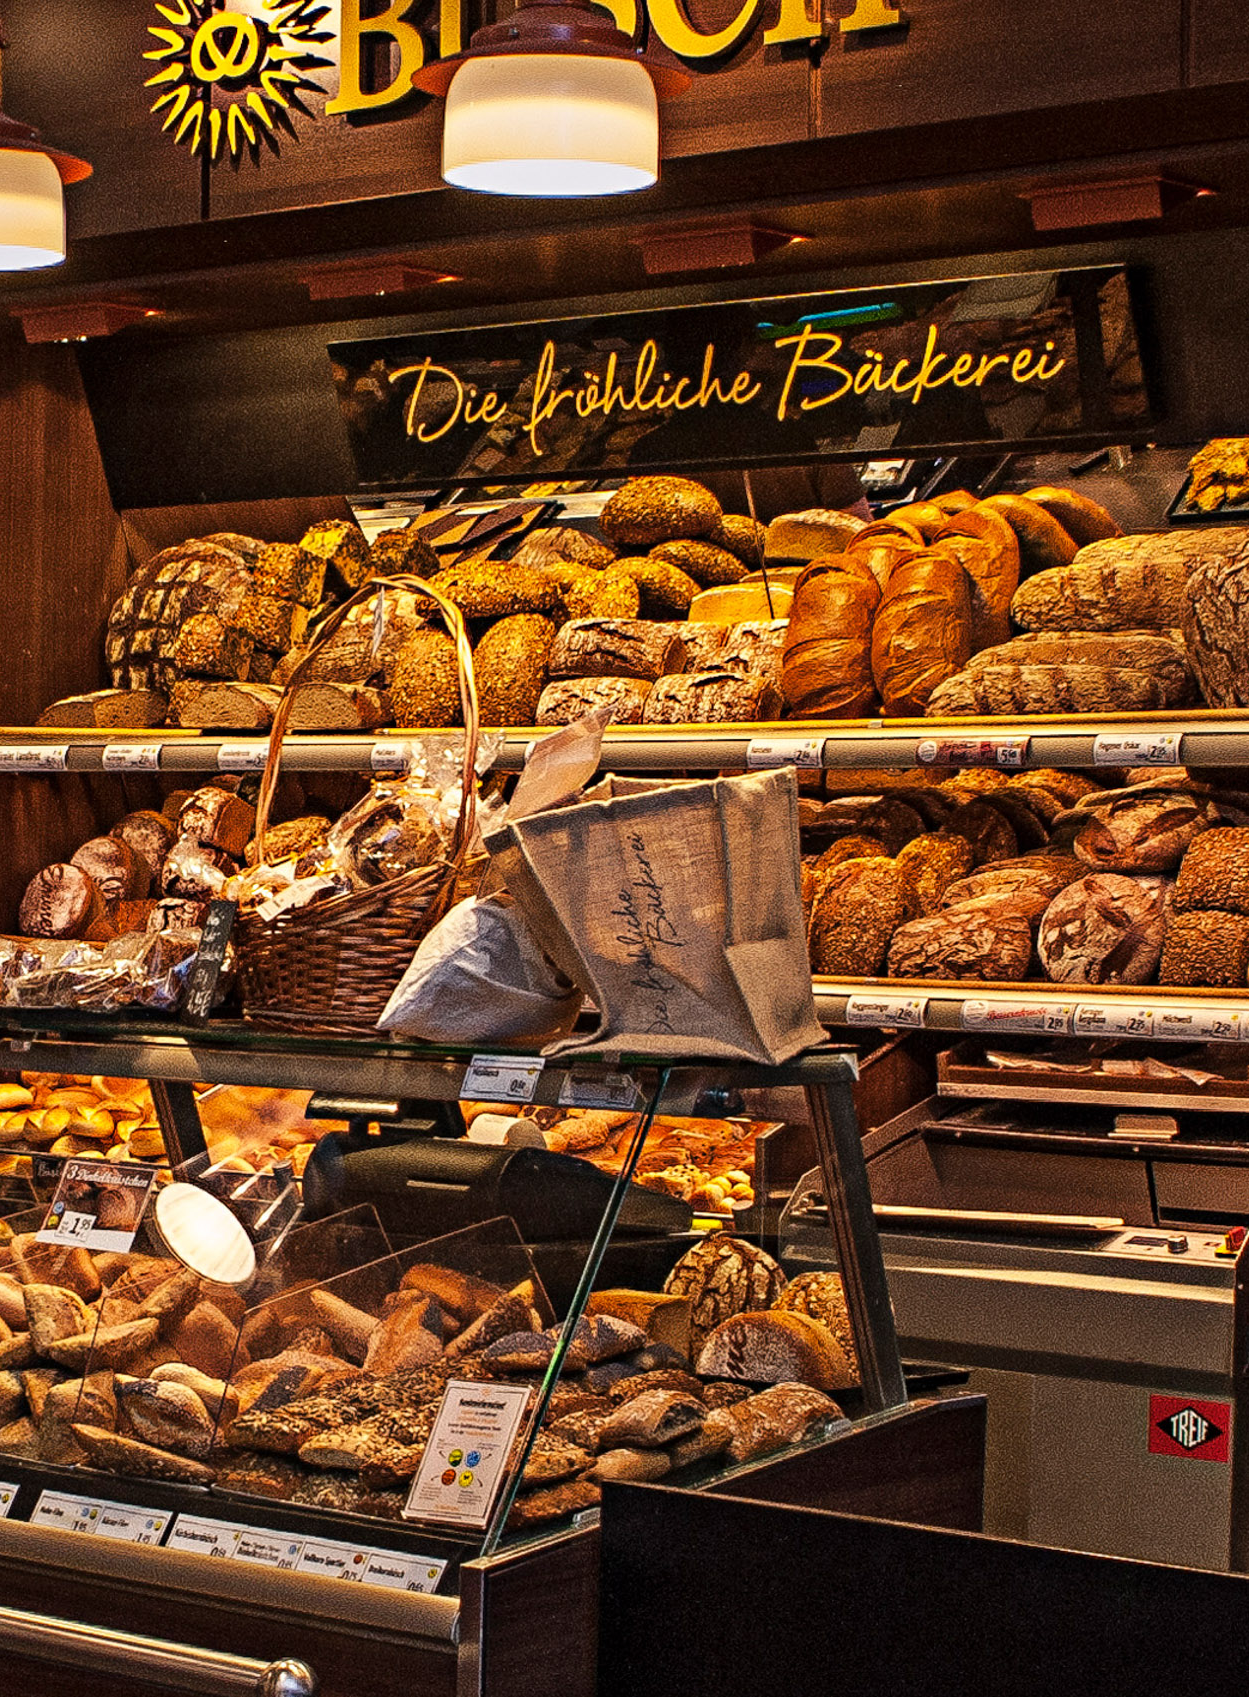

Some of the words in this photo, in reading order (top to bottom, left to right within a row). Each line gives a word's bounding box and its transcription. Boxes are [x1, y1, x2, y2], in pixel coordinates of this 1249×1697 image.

[388, 357, 508, 442] Die
[522, 339, 761, 456] fröhliche
[775, 324, 1066, 421] Bäckerei
[1170, 1409, 1209, 1448] TREIF
